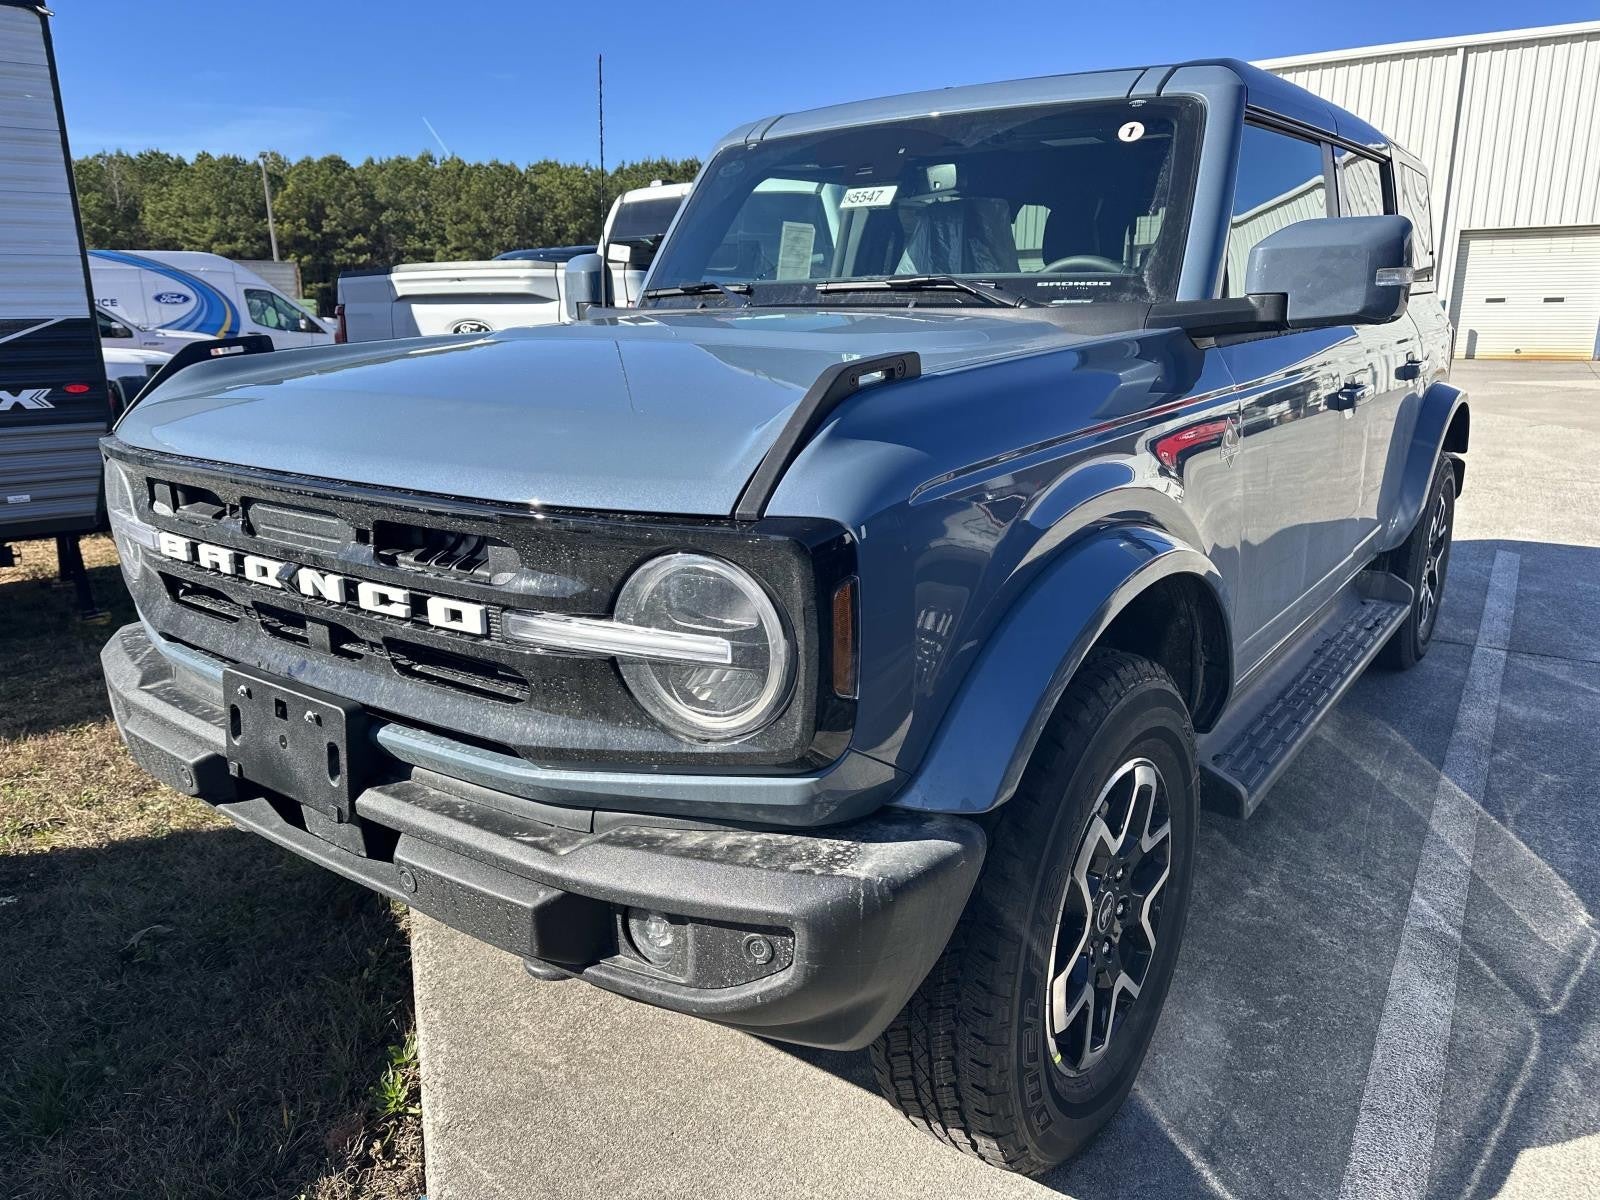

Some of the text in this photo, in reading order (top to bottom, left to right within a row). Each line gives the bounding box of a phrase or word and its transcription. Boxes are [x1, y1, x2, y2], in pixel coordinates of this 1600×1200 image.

[1127, 125, 1136, 138] 1
[95, 298, 118, 307] ICE
[158, 293, 186, 304] Ford
[157, 530, 487, 636] BRONCO
